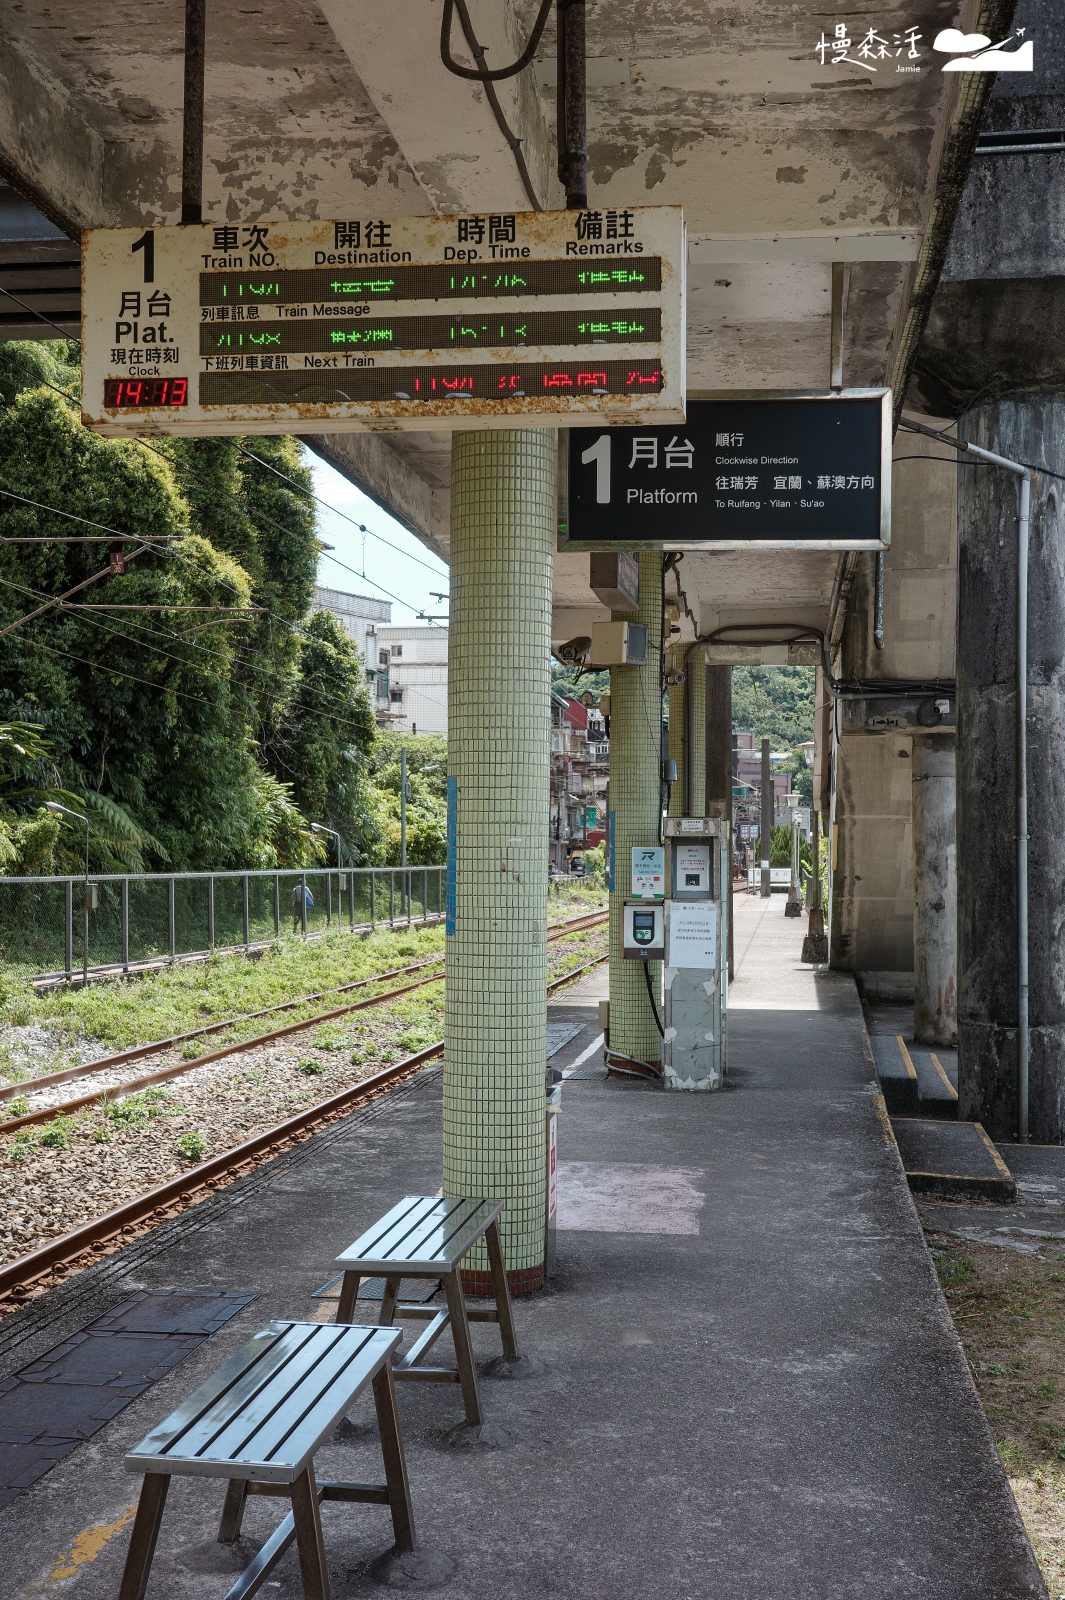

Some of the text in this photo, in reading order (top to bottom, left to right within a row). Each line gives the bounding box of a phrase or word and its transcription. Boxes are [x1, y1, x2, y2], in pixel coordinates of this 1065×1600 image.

[457, 215, 516, 244] 時間
[574, 210, 635, 240] 備註
[212, 225, 270, 253] 車次
[334, 221, 392, 249] 開往
[444, 244, 531, 263] Dep. Time
[565, 240, 644, 256] Remarks
[131, 230, 155, 283] 1
[201, 253, 280, 269] Train NO.
[314, 249, 412, 265] Destination
[118, 290, 172, 318] 月台
[276, 304, 371, 317] Train Message
[201, 305, 260, 321] 列車訊息
[115, 321, 174, 344] Plat.
[110, 347, 179, 365] 現在時刻
[200, 355, 289, 371] 下班列車資訊
[304, 355, 375, 368] Next Train
[128, 366, 160, 376] Clock
[114, 379, 188, 406] 14:13
[715, 432, 744, 447] 順行
[628, 435, 696, 469] 月台
[715, 456, 799, 465] Clockwise Direction
[581, 434, 611, 504] 1
[715, 475, 759, 490] 往瑞芳
[627, 488, 698, 504] Platform
[715, 499, 825, 510] To Ruifang Yilan Su'ao
